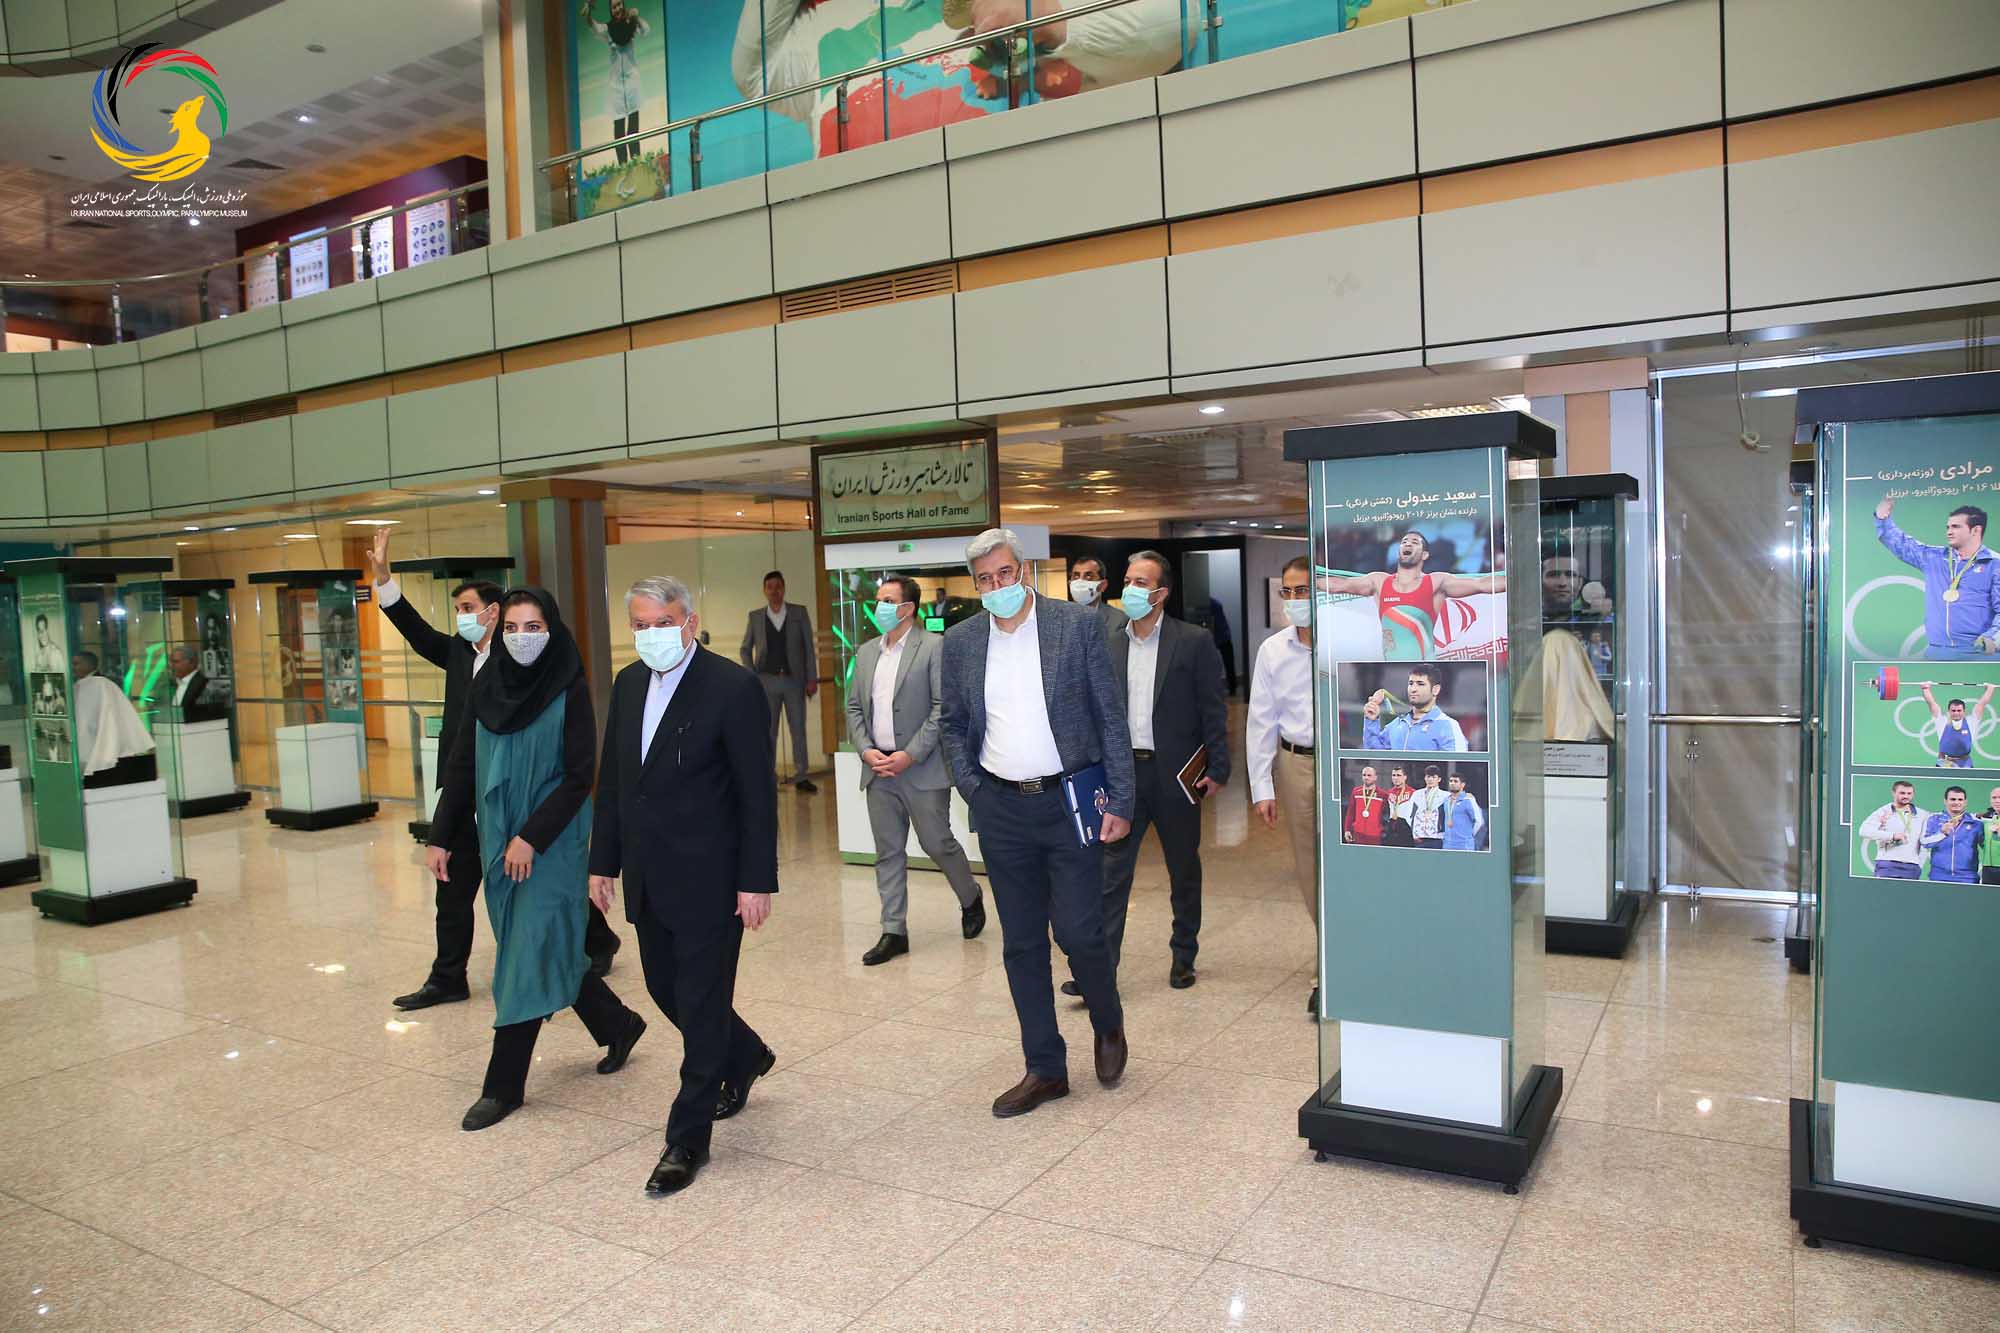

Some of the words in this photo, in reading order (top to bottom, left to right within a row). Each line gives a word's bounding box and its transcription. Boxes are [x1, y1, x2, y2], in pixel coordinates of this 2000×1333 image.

[869, 461, 910, 495] ورزش
[905, 460, 947, 495] مشاهیر
[945, 462, 973, 484] تالار
[1939, 460, 1993, 480] مرادی
[832, 475, 868, 498] ایران
[1962, 482, 1988, 492] ۲۰۱۶
[1396, 491, 1440, 508] عبدولی
[1443, 491, 1476, 503] سعید
[837, 512, 870, 524] Iranian
[872, 509, 904, 523] Sports
[907, 507, 926, 519] Hall
[928, 506, 939, 517] of
[941, 504, 969, 516] Fame
